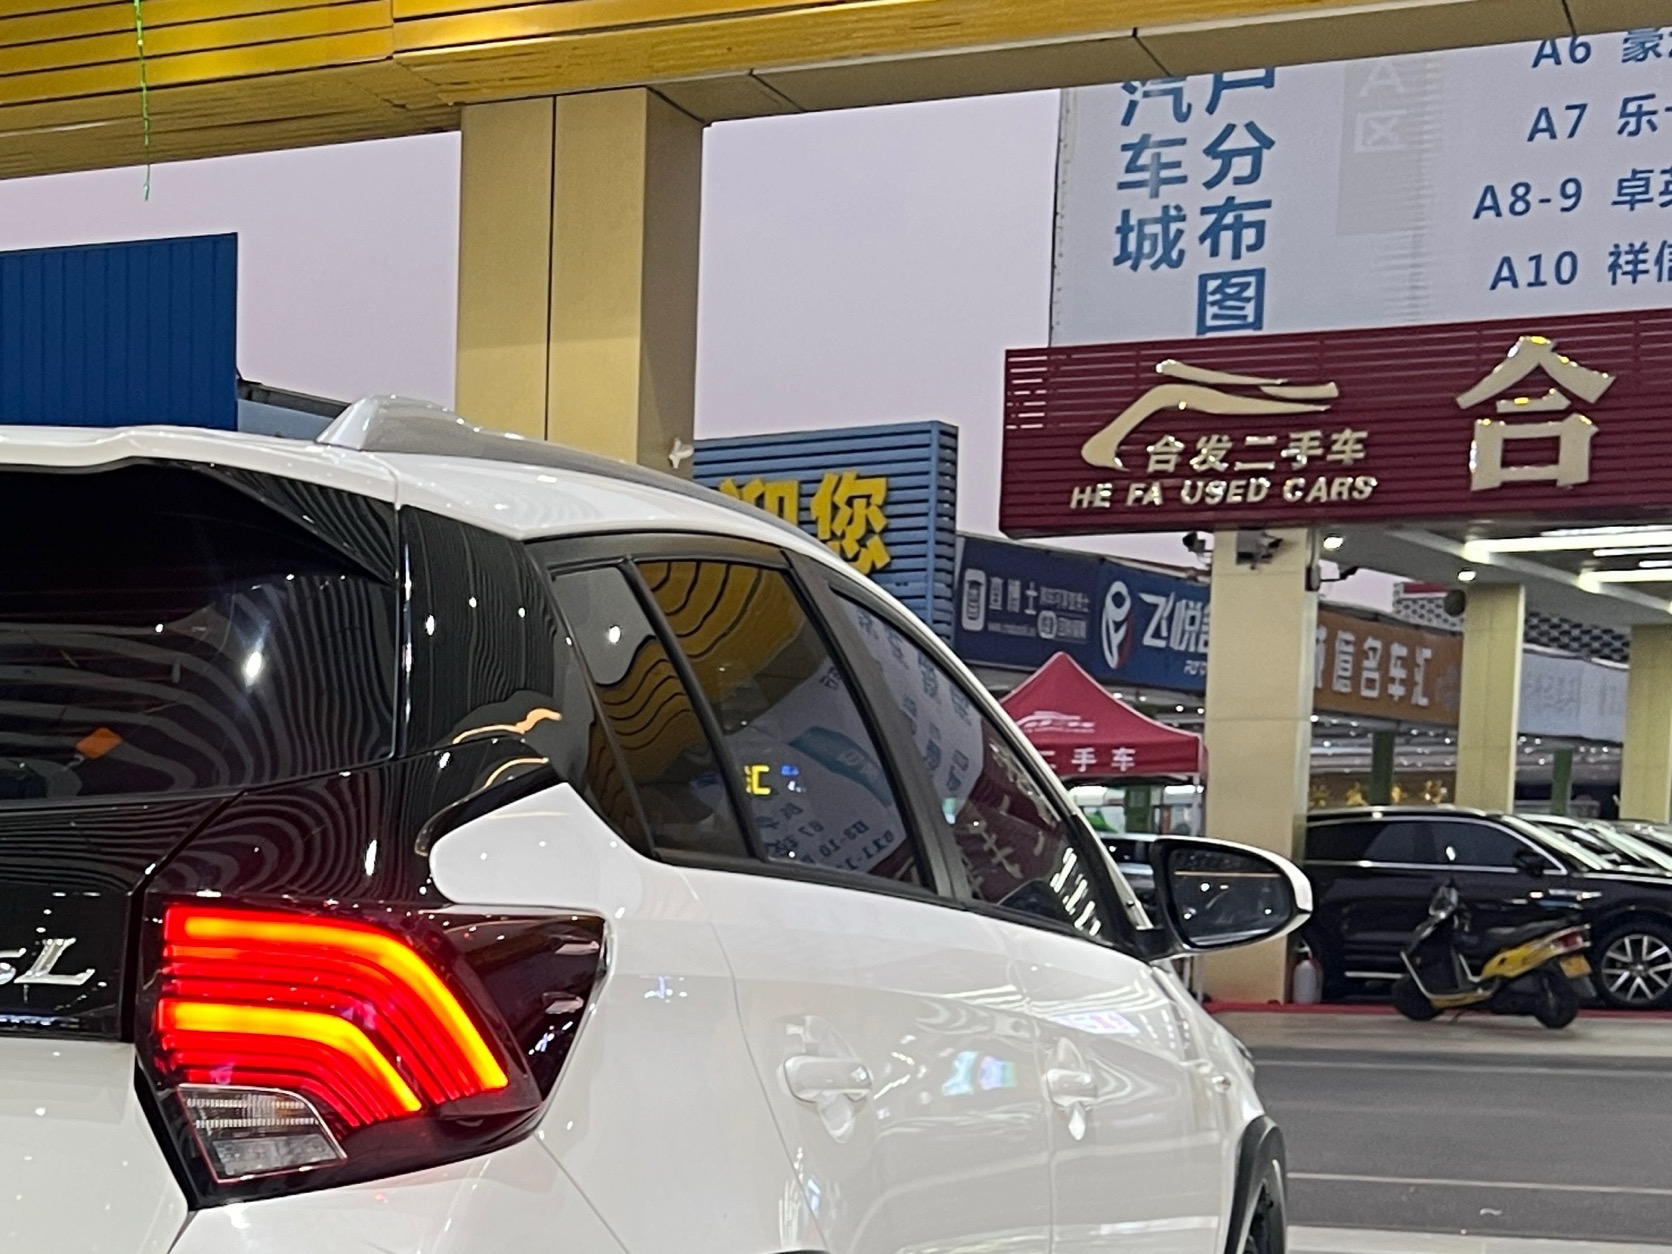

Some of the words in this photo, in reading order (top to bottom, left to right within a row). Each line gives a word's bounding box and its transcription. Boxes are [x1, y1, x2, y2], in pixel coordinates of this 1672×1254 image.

[1532, 36, 1591, 68] A6
[1527, 103, 1588, 142] A7
[1617, 93, 1672, 137] 乐
[1113, 76, 1191, 272] 汽车城
[1473, 177, 1583, 220] A8-9
[1489, 250, 1578, 290] A10
[1146, 428, 1368, 473] 合发二手车
[1070, 483, 1113, 509] HE
[1126, 481, 1164, 506] FA
[1181, 477, 1271, 505] USED
[1283, 476, 1378, 503] CARS
[13, 937, 96, 986] L
